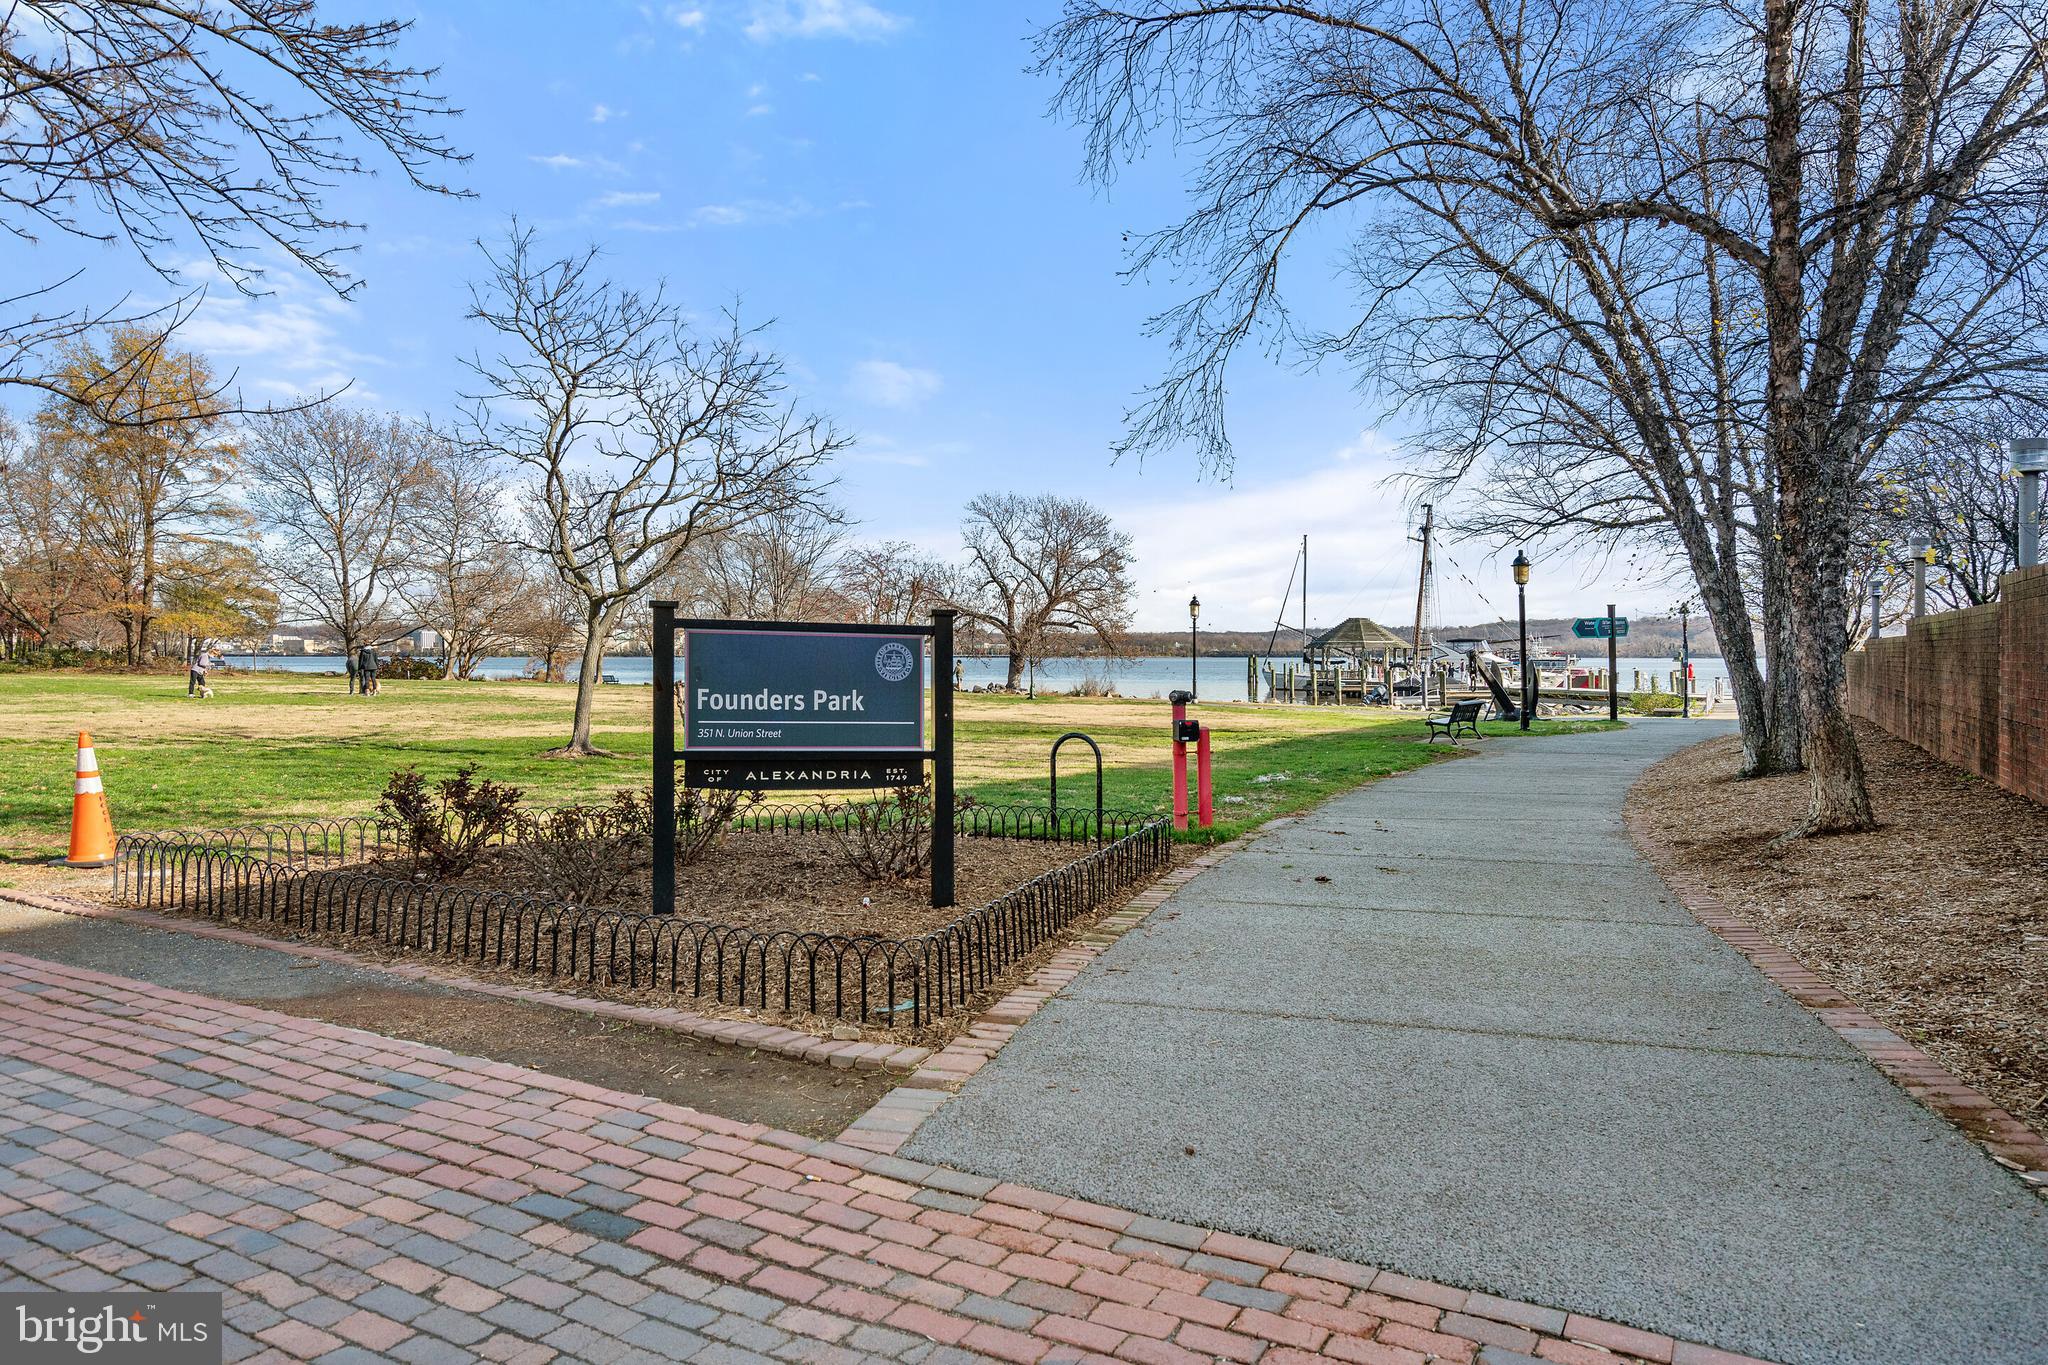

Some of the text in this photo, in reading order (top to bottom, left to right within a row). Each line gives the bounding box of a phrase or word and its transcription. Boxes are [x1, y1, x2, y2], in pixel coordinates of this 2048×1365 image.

[697, 688, 865, 711] Founders Park
[697, 728, 782, 738] 351 N. Union Street
[745, 769, 872, 781] ALEXANDRIA
